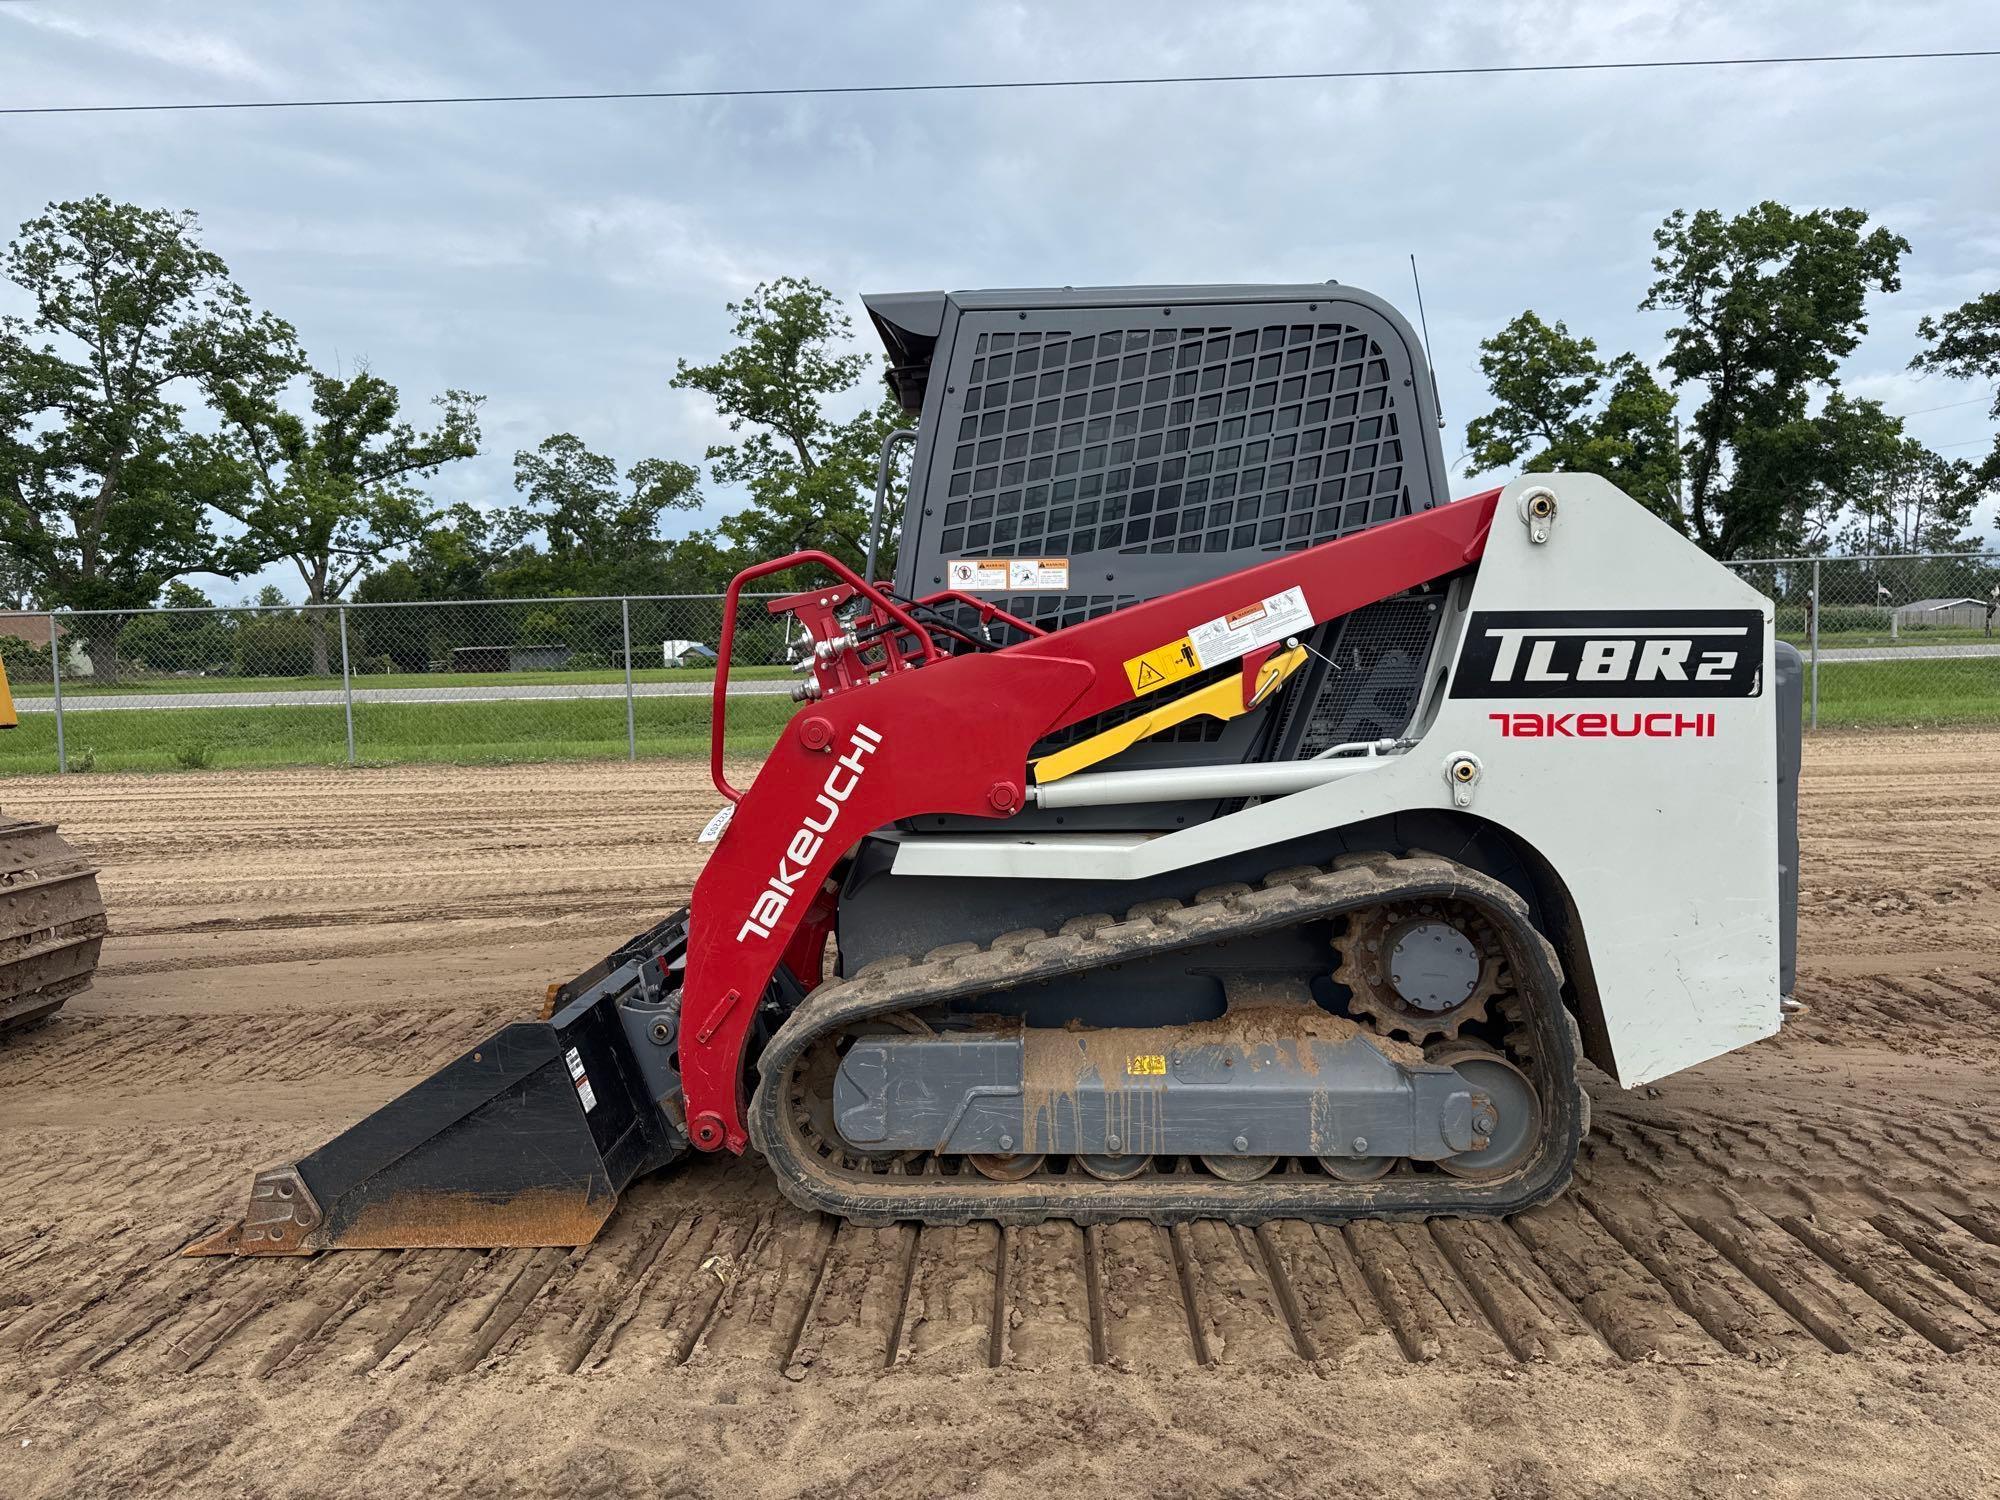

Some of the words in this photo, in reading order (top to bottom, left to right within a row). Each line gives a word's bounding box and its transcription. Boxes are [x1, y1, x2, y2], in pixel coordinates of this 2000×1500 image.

[1485, 628, 1748, 682] TL8R2
[1488, 713, 1716, 738] TAKEUCHI
[736, 723, 883, 943] TAKEUCHI
